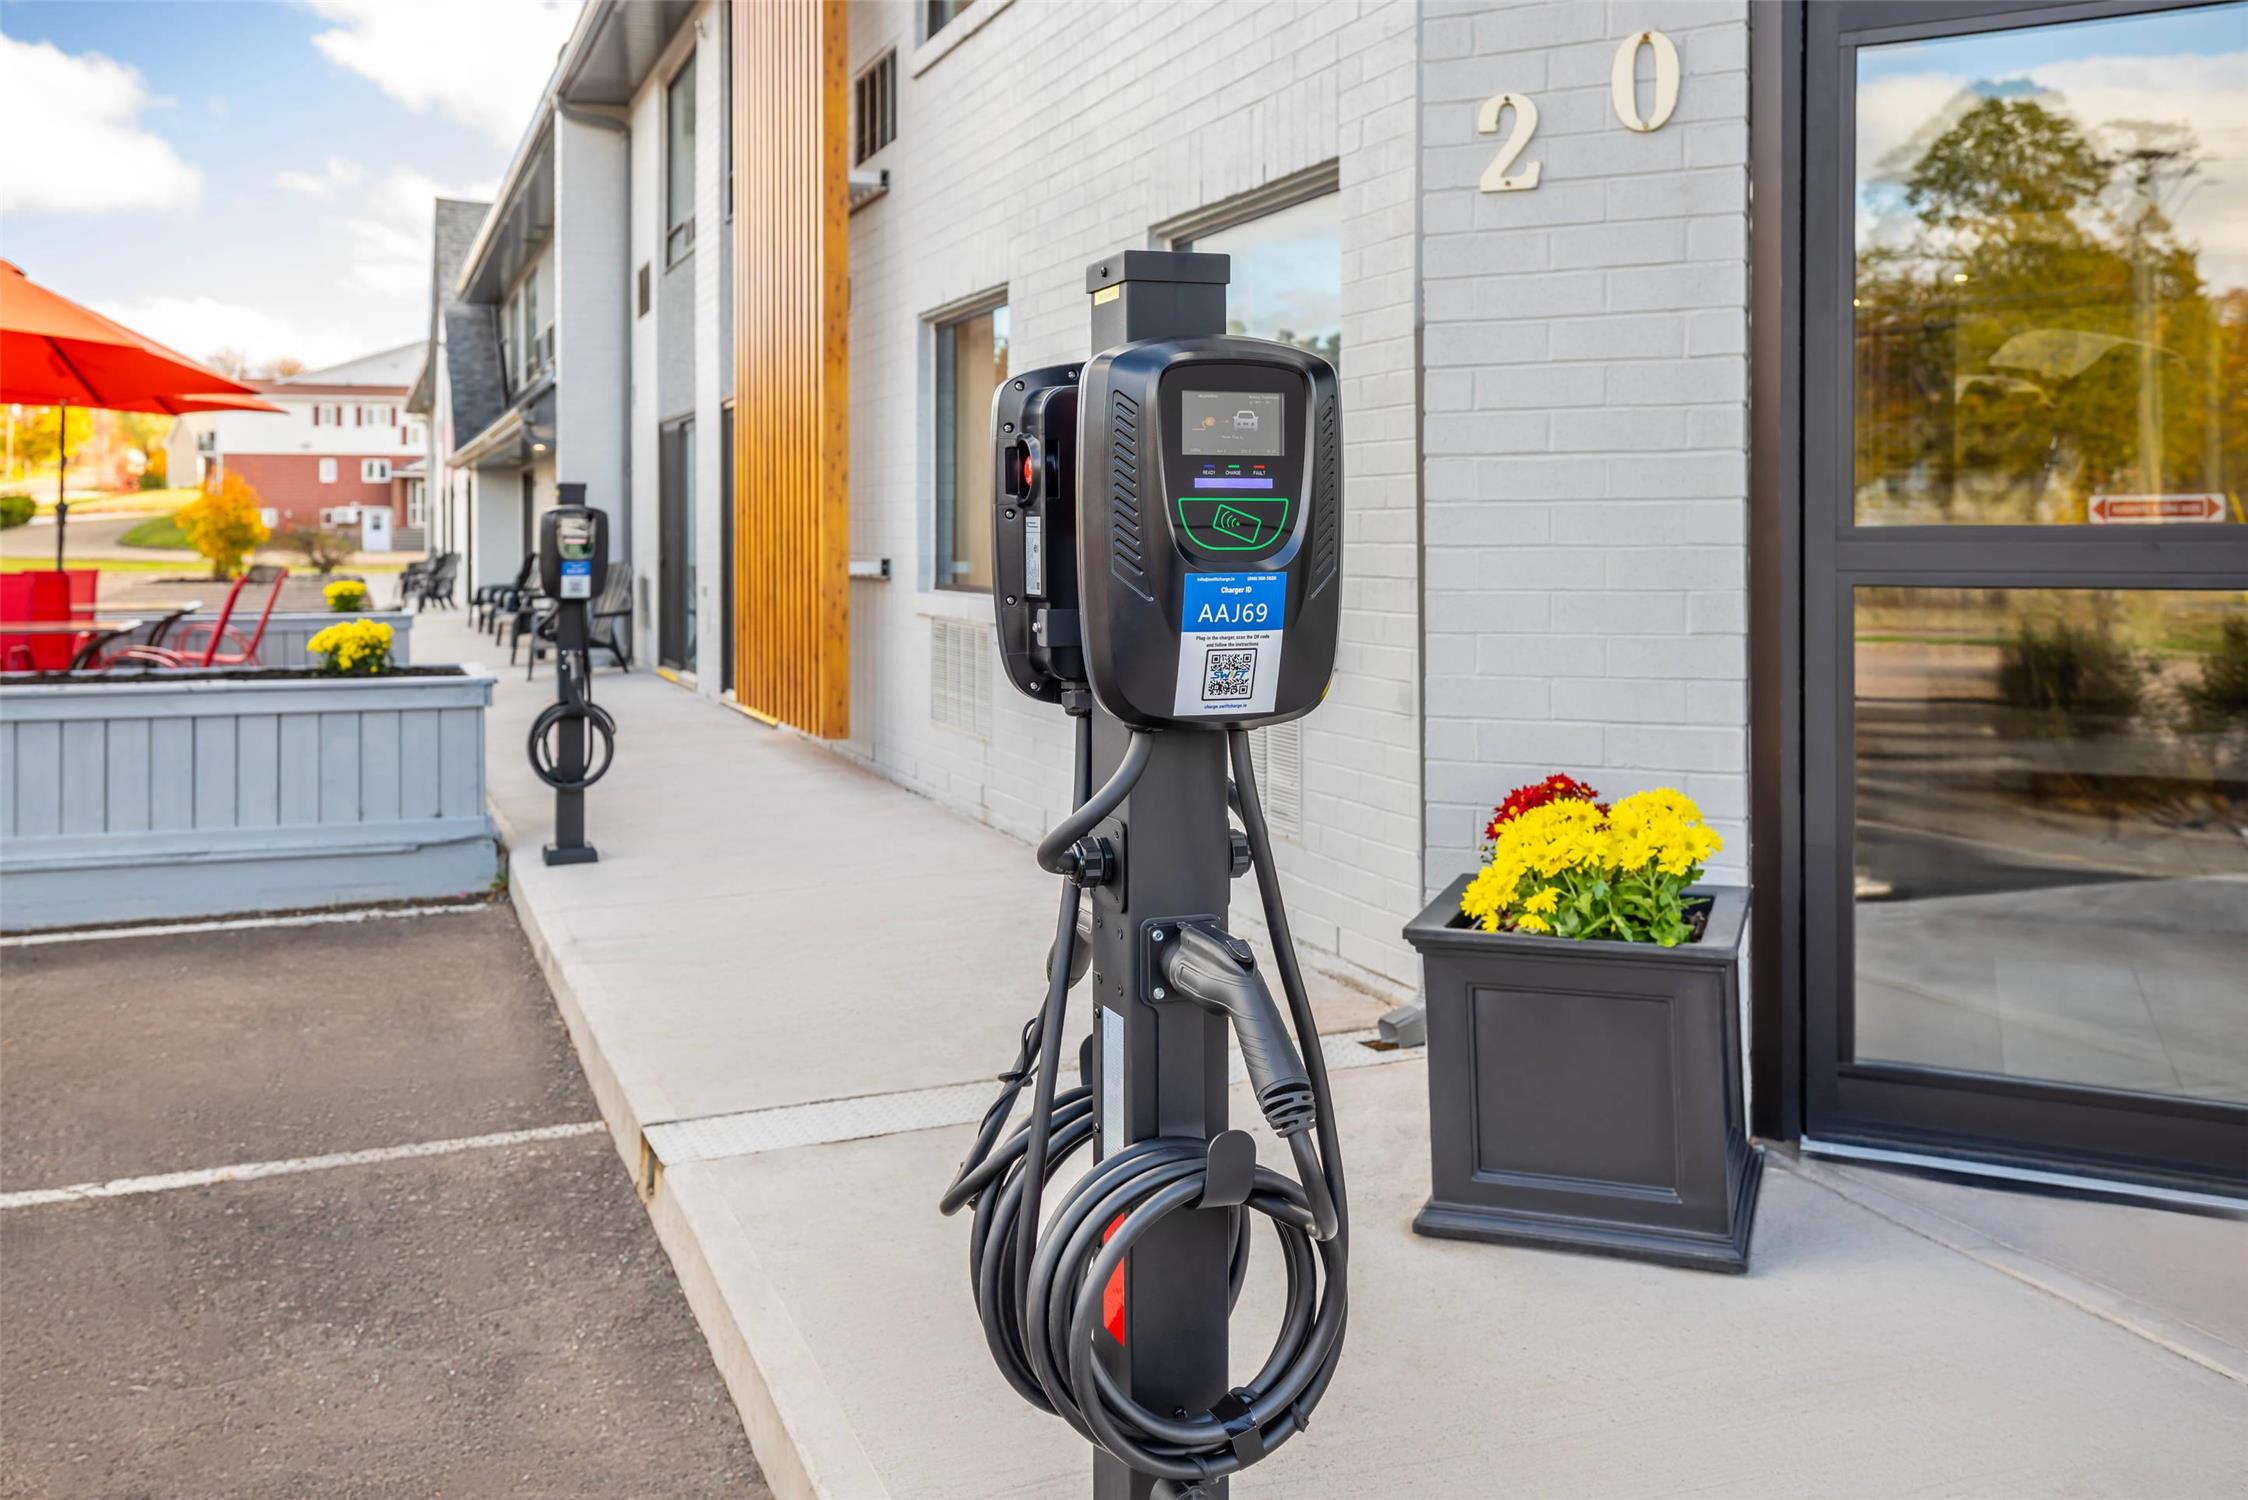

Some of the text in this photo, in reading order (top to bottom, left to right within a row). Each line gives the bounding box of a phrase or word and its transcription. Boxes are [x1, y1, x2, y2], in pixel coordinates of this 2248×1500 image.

[1220, 586, 1244, 594] Charger
[1198, 603, 1268, 622] AAJ69
[1210, 670, 1249, 679] SWIFT
